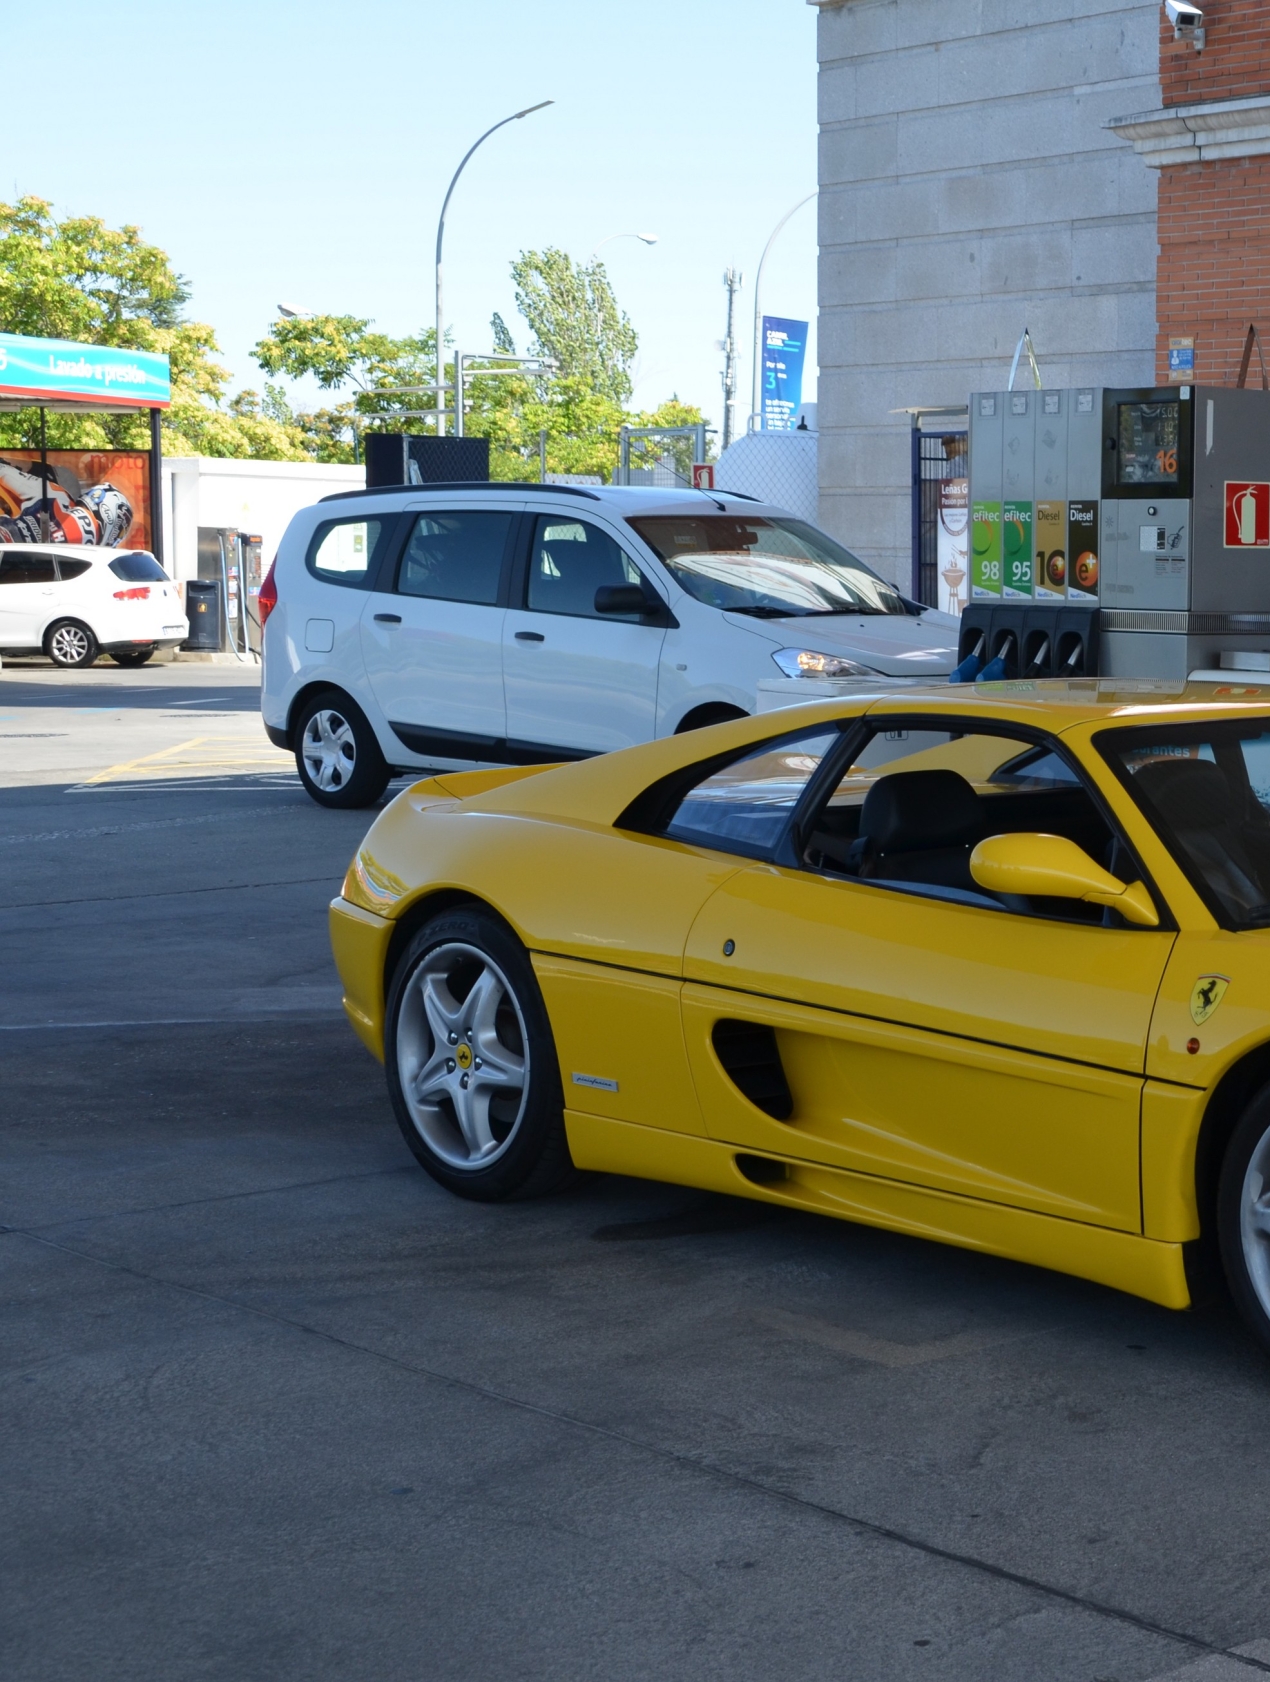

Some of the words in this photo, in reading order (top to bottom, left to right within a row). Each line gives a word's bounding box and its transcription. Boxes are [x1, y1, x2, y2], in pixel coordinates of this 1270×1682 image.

[49, 355, 92, 379] Lavado
[95, 366, 103, 378] a
[104, 364, 146, 386] presión
[766, 371, 777, 389] 3
[91, 452, 146, 470] moto
[1156, 449, 1177, 474] 16
[941, 484, 961, 495] Leñas
[973, 510, 1000, 522] efitec
[1004, 510, 1032, 522] efitec
[1037, 510, 1060, 521] Diesel
[1070, 510, 1093, 521] Diesel
[981, 560, 1000, 580] 98
[1012, 561, 1031, 581] 95
[1036, 549, 1065, 587] 10
